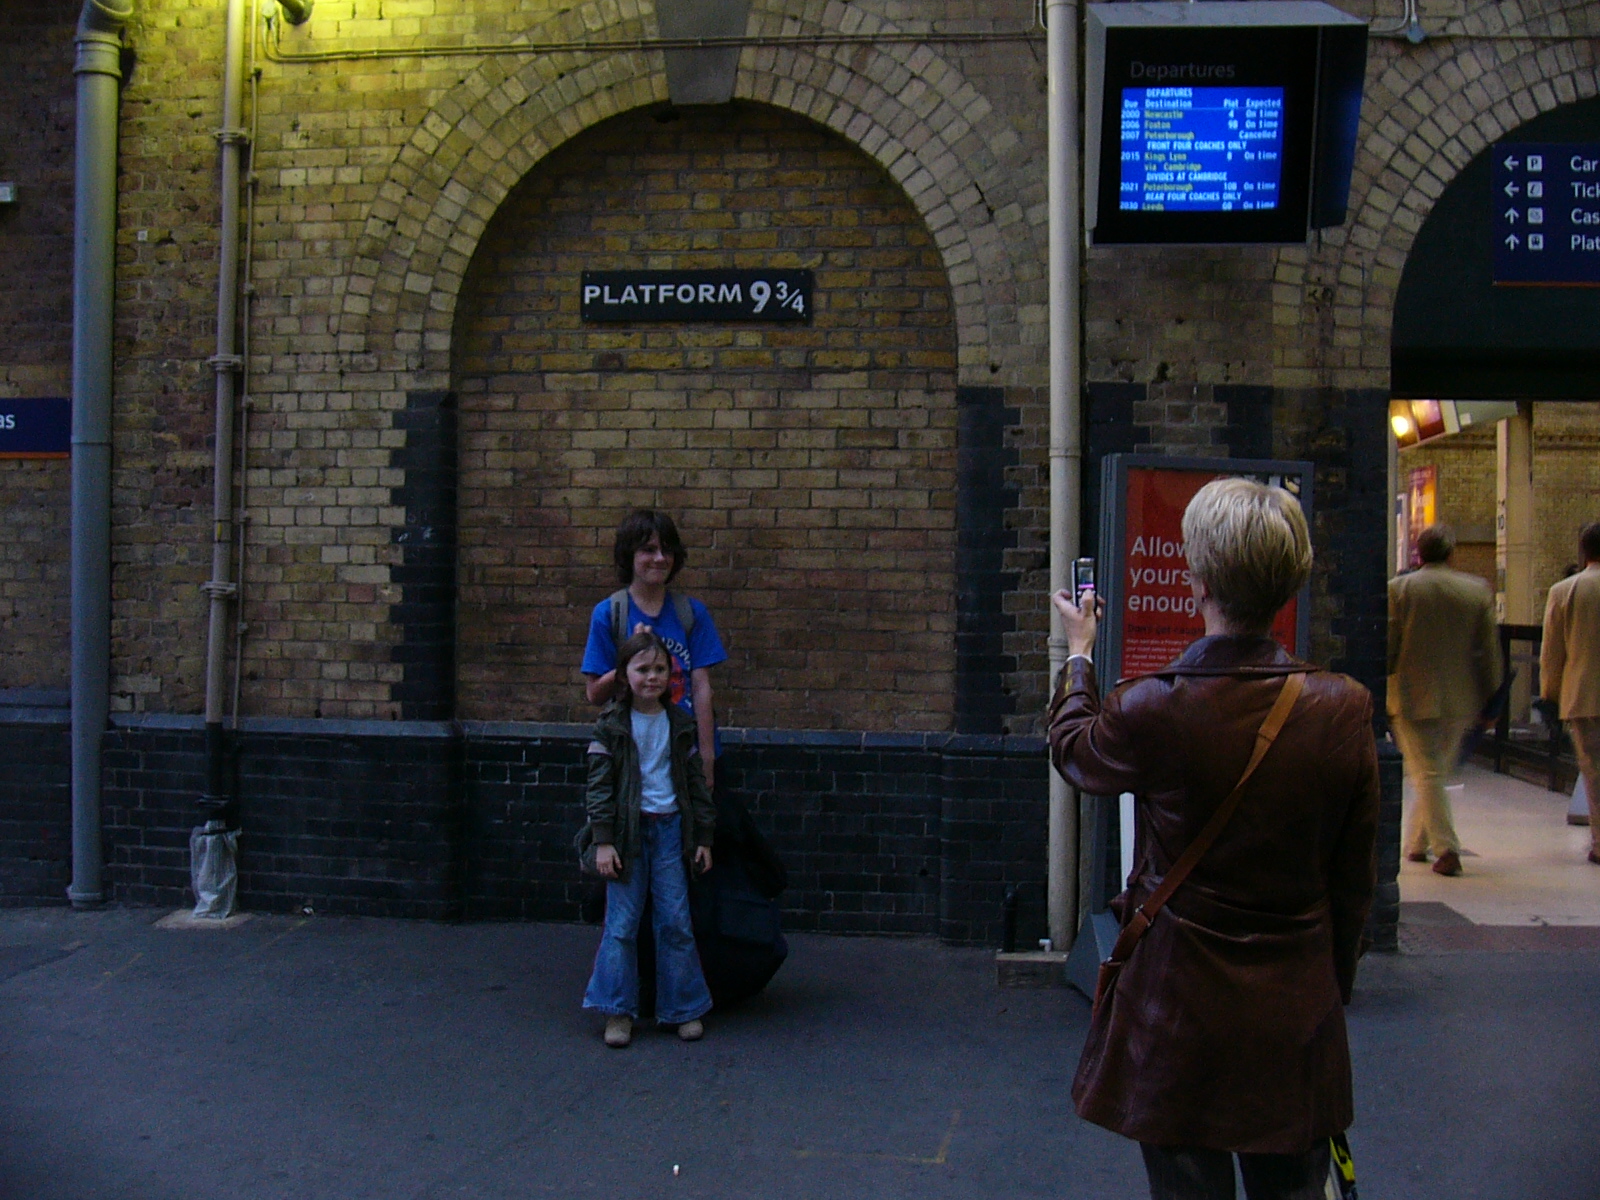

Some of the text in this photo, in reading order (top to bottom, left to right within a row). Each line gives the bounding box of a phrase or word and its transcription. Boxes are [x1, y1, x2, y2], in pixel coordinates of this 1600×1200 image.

[1130, 61, 1236, 81] Departures
[1146, 88, 1193, 97] DEPARTURES
[1124, 98, 1281, 109] Due Destination Plat Expected
[1145, 109, 1184, 119] Newcastle
[1228, 109, 1234, 118] 4
[1245, 109, 1257, 118] On
[1259, 109, 1278, 118] time
[1245, 119, 1256, 129] On
[1259, 119, 1278, 129] time
[1121, 130, 1277, 140] 2007 Peterborough Cancelled
[1147, 140, 1247, 150] FRONT FOUR COACHES ONLY
[1121, 151, 1140, 161] 2015
[1145, 152, 1166, 162] Kings
[1169, 152, 1187, 162] Lynn
[1244, 151, 1255, 160] On
[1258, 150, 1277, 160] time
[1144, 162, 1202, 172] via Cambridge
[1570, 155, 1599, 172] Car
[1146, 171, 1227, 181] DIVIDES AT CAMBRIDGE
[1120, 182, 1139, 191] 2021
[1144, 182, 1193, 192] Peterborough
[1243, 181, 1254, 191] On
[1257, 181, 1276, 191] time
[1145, 191, 1242, 201] REAR FOUR COACHES ONLY
[1243, 201, 1253, 210] On
[1256, 200, 1275, 210] time
[584, 283, 742, 304] PLATFORM
[1128, 594, 1196, 618] enoug
